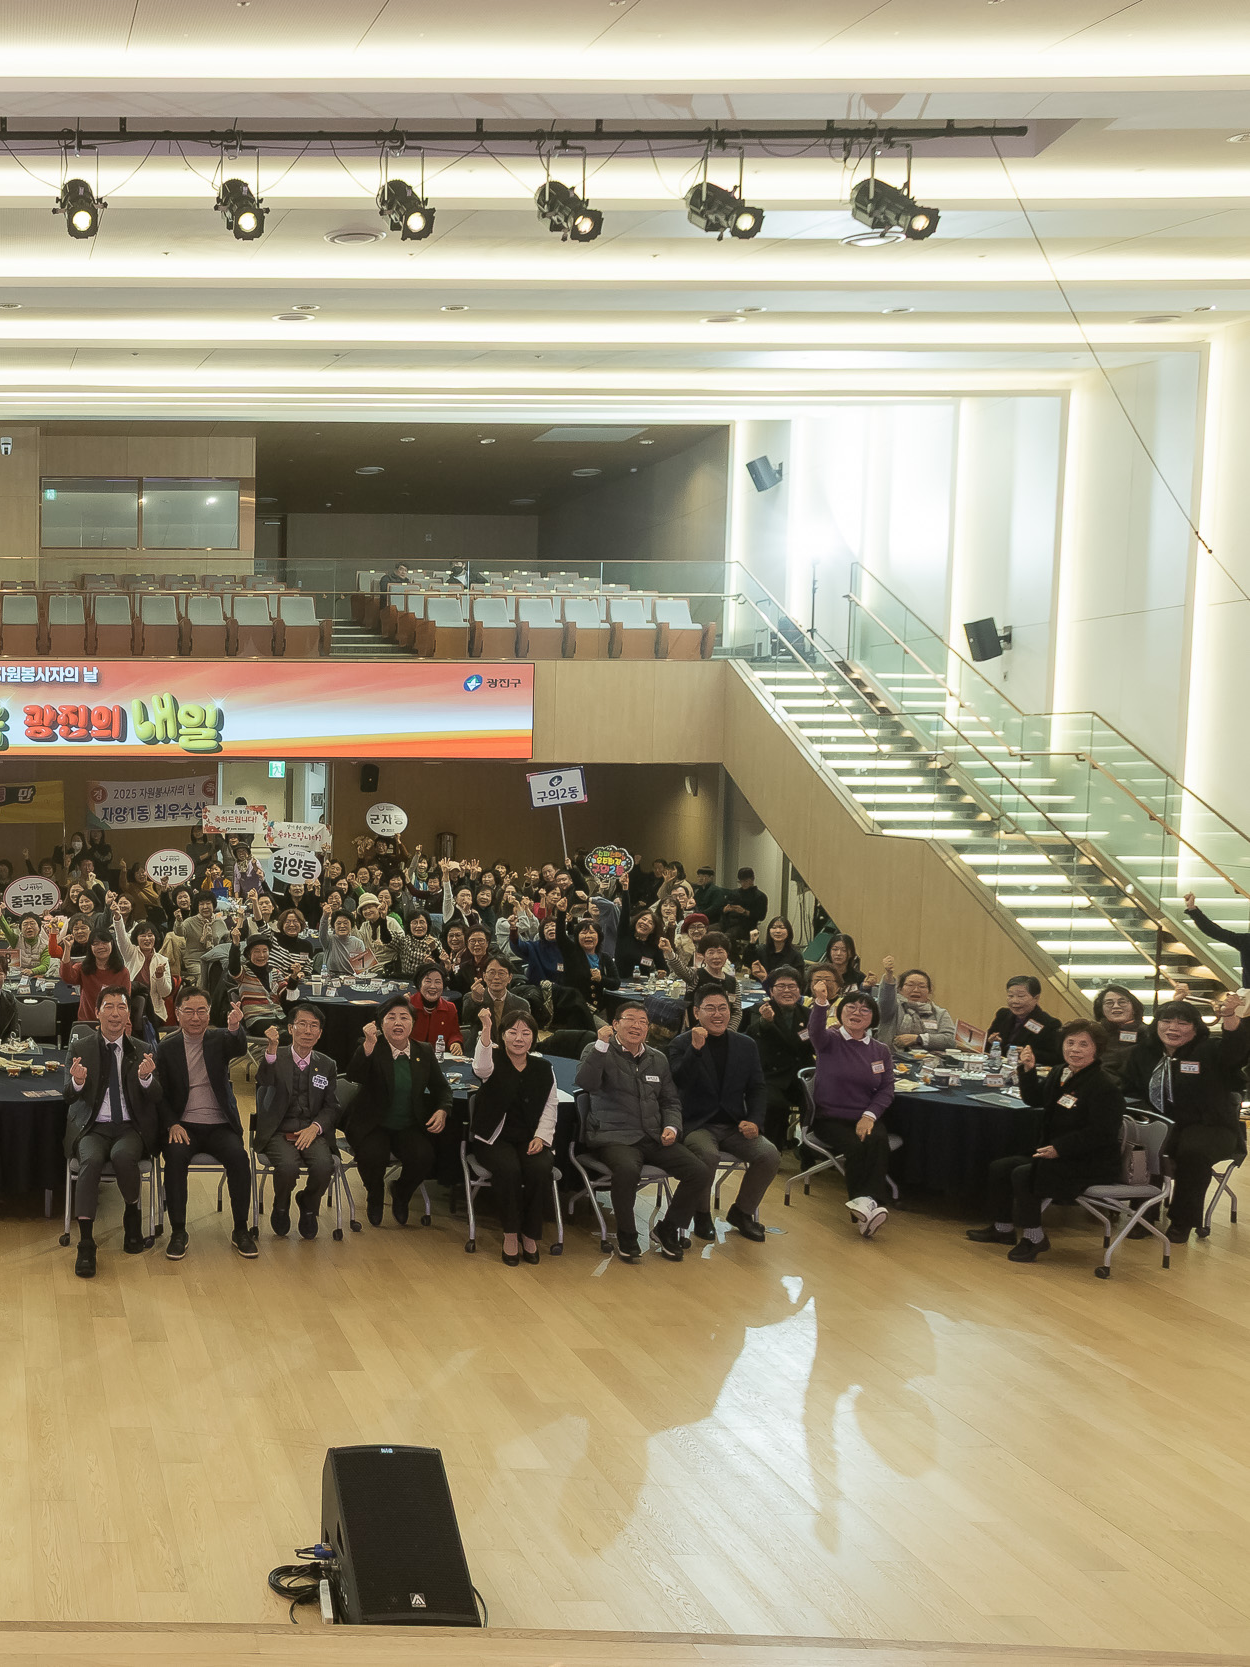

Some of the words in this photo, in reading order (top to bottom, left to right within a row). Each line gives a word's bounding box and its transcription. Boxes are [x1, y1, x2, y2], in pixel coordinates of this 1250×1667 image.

[83, 666, 99, 683] 날
[486, 678, 521, 688] 광진구
[23, 704, 122, 741] 광진의
[131, 692, 221, 751] 내일
[17, 787, 35, 803] 만
[113, 789, 137, 800] 2025
[139, 785, 185, 800] 자원봉사자의
[187, 783, 195, 796] 날
[537, 786, 579, 803] 구의2동
[101, 805, 150, 823] 자양1동
[154, 801, 207, 820] 최우수상
[370, 814, 404, 825] 군자동
[152, 864, 188, 876] 자양1동
[272, 855, 316, 879] 화양동
[11, 892, 53, 909] 중곡2동
